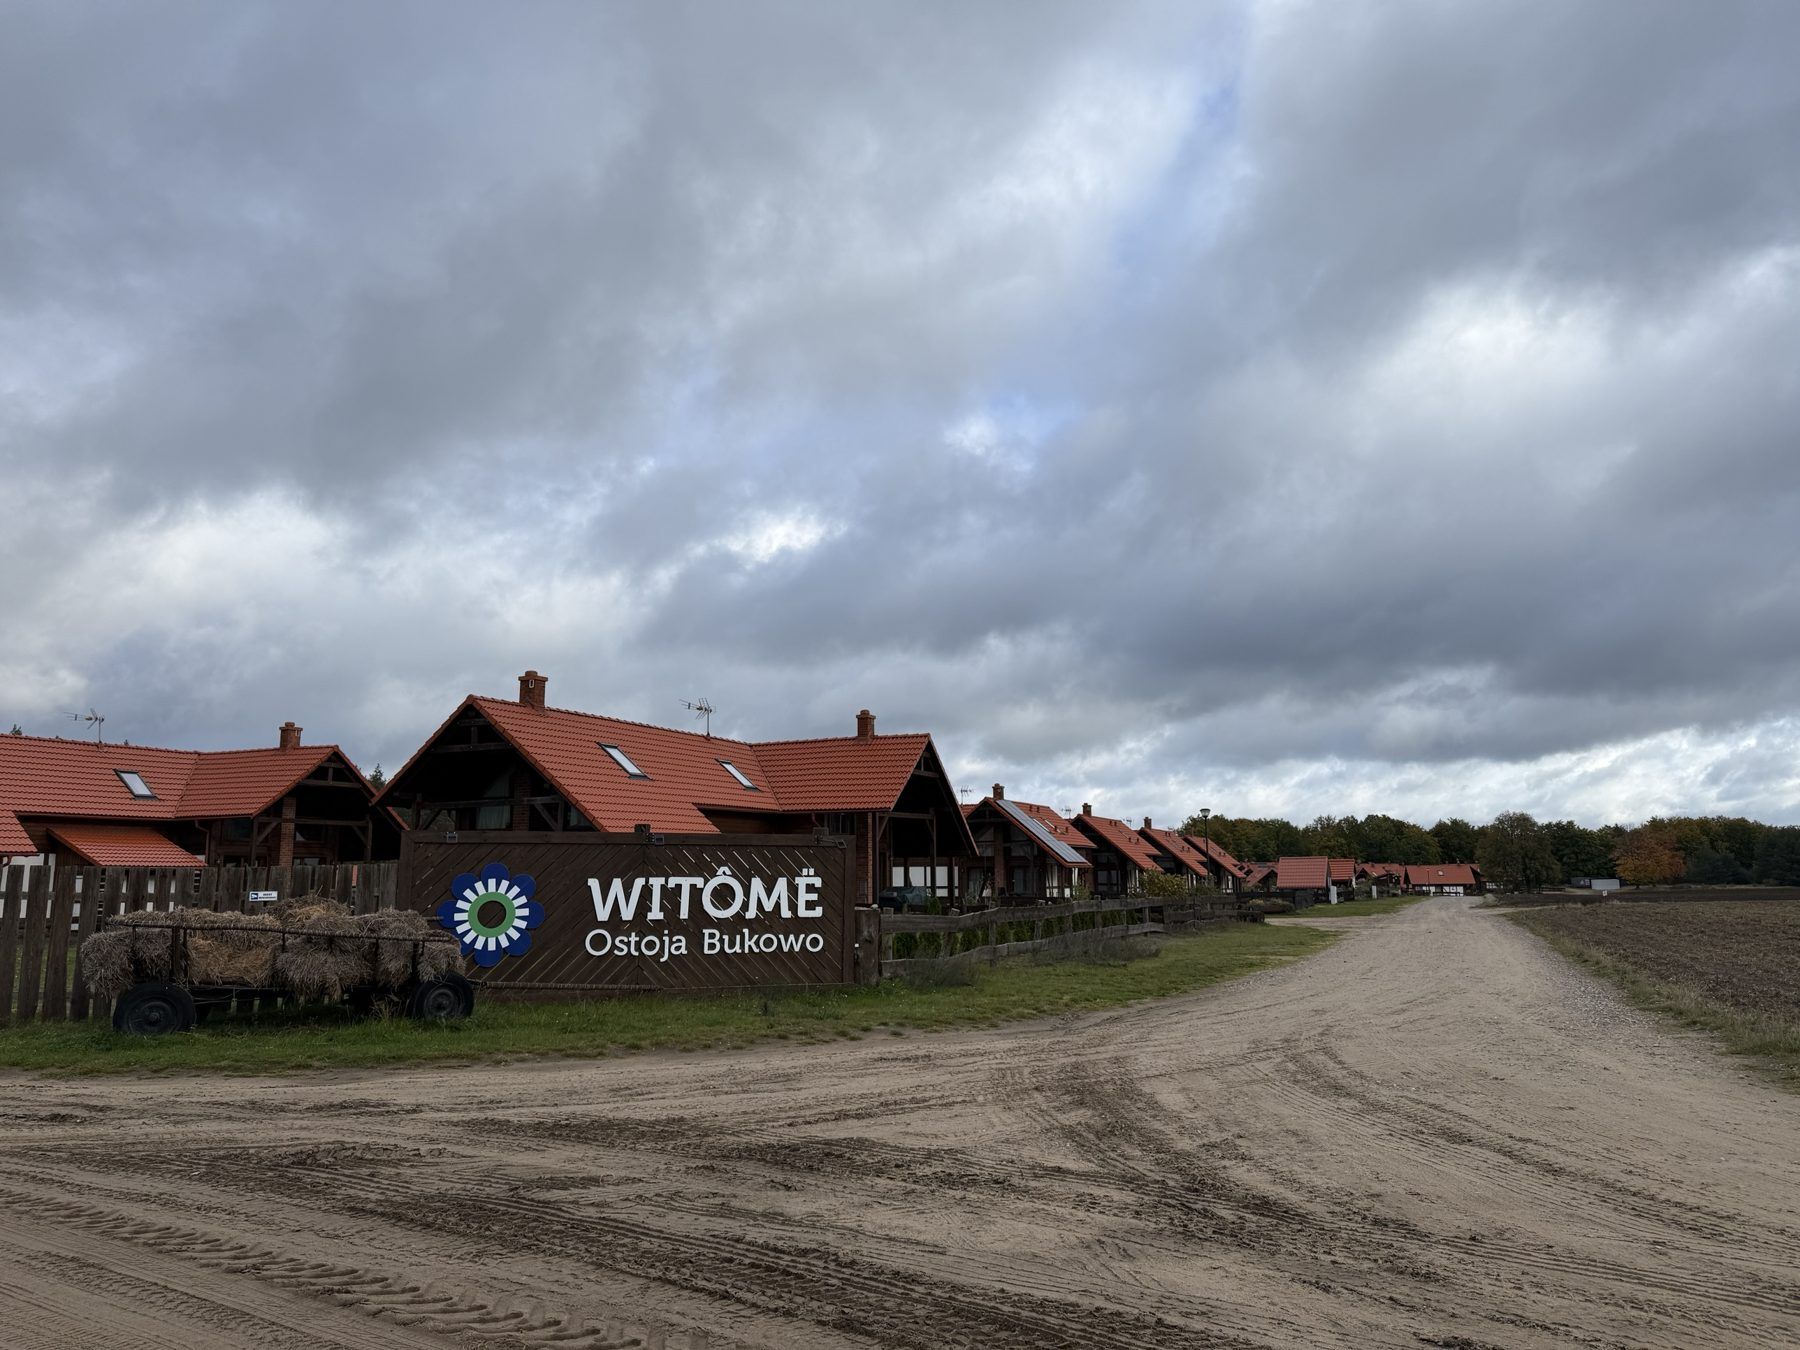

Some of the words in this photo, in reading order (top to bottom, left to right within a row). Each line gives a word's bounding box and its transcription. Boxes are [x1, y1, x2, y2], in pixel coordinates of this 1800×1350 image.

[587, 866, 823, 921] WITÔMË
[585, 928, 688, 962] Ostoja
[702, 928, 824, 955] Bukowo
